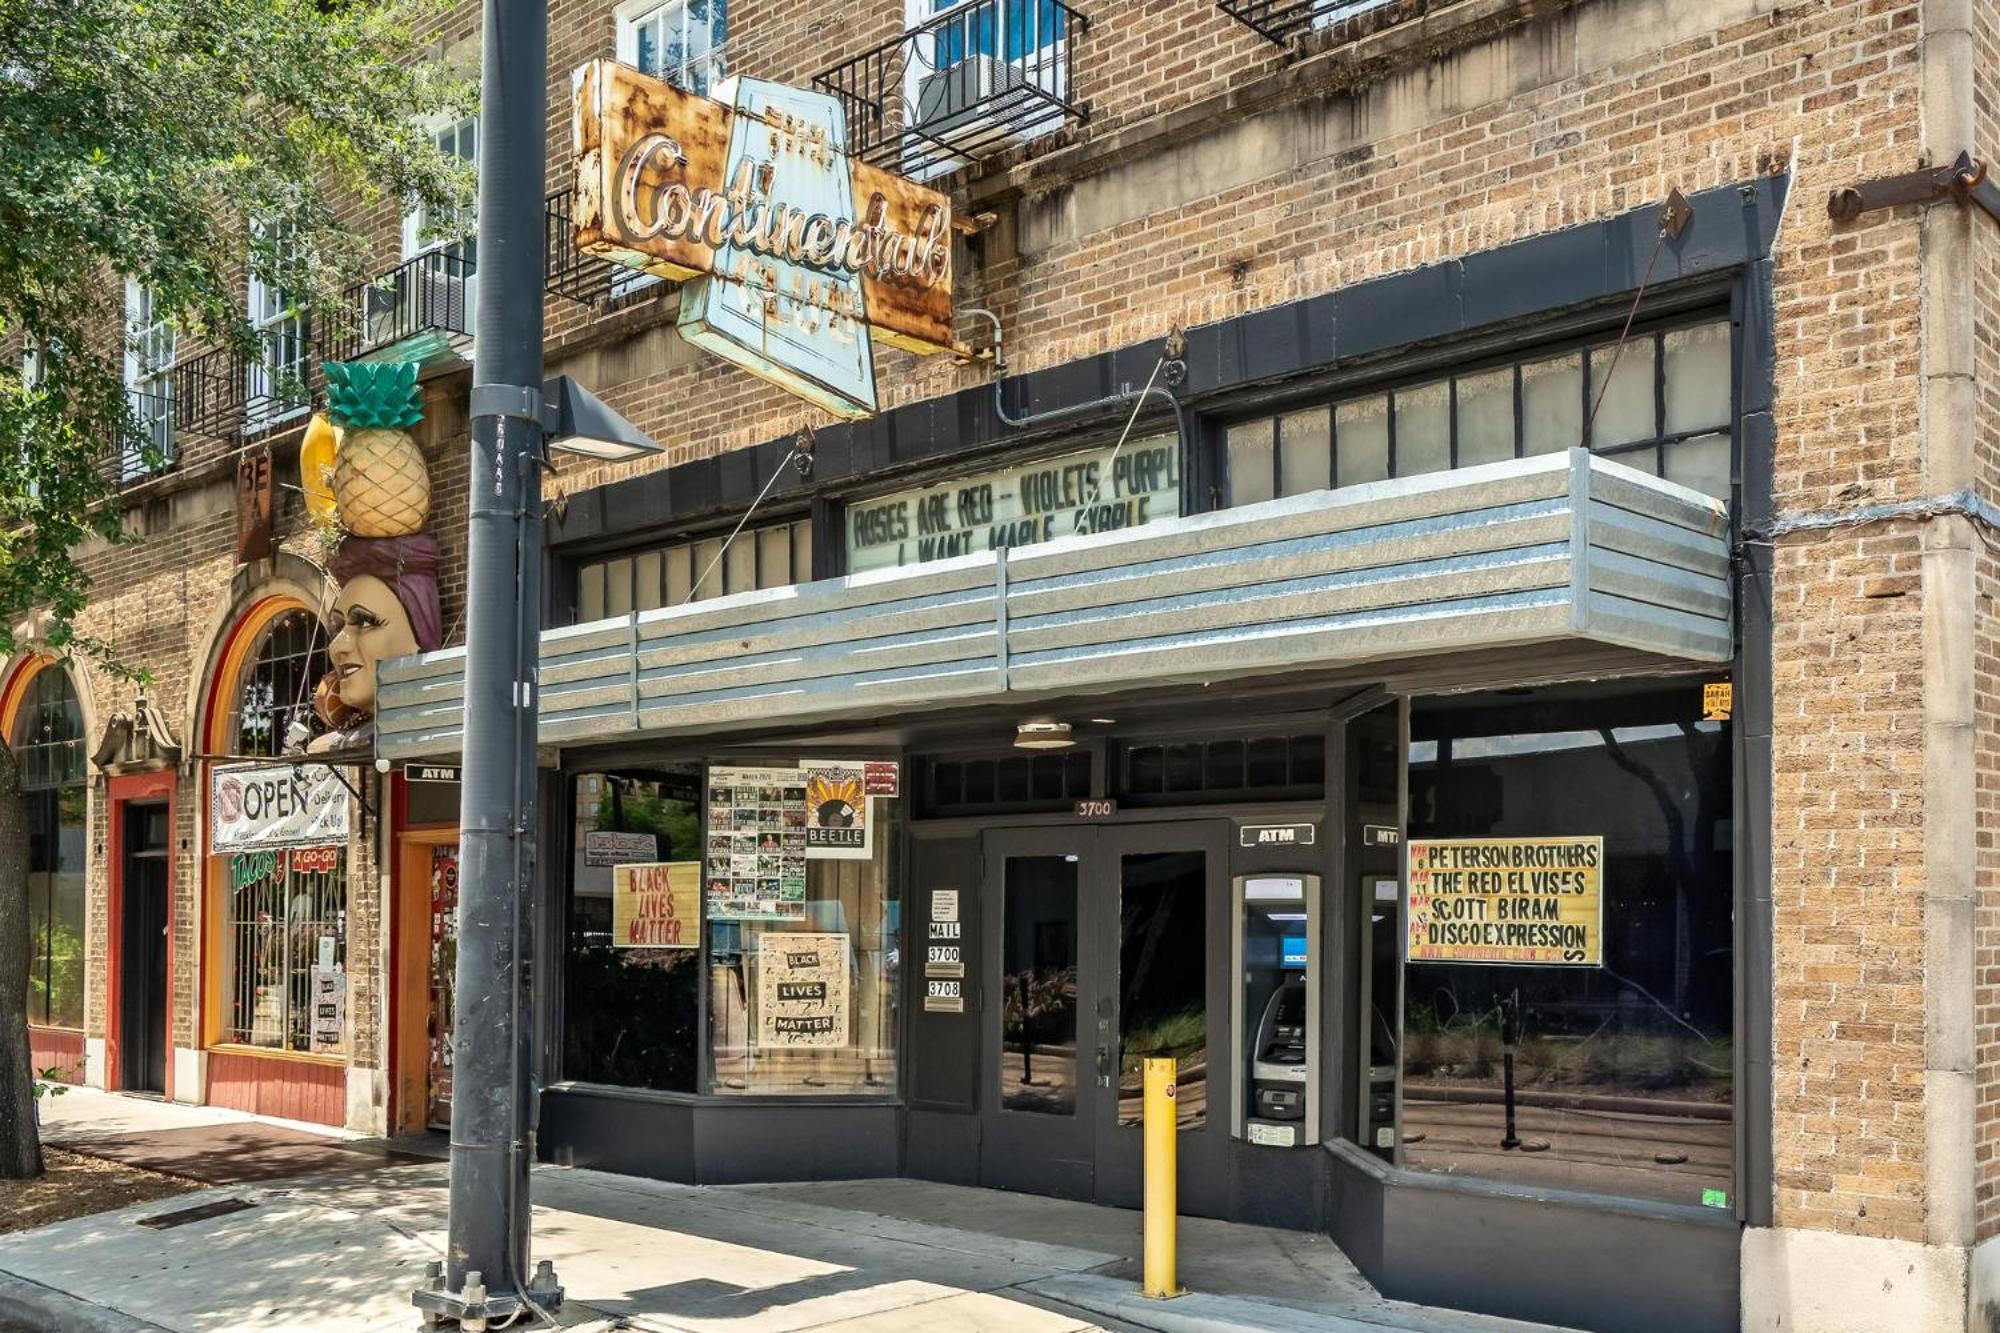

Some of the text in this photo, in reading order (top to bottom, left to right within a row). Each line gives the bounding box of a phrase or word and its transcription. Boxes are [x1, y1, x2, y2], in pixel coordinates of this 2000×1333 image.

[612, 132, 950, 286] Continental
[853, 501, 909, 548] ROSES
[917, 492, 952, 536] ARE
[957, 483, 993, 528] RED
[1020, 460, 1100, 515] VIOLETS
[1113, 446, 1179, 498] PURPL
[918, 530, 973, 563] WANT
[421, 768, 454, 779] ATM
[244, 777, 308, 820] OPEN
[1079, 801, 1111, 817] 3700
[810, 829, 861, 842] BEETLE
[1258, 829, 1295, 843] ATM
[295, 850, 337, 862] A GO-GO
[1429, 846, 1510, 868] PETERSON
[1513, 844, 1597, 868] BROTHERS
[232, 850, 277, 894] TACOS
[630, 867, 671, 893] BLACK
[1432, 872, 1463, 894] THE
[1468, 872, 1500, 894] RED
[1508, 871, 1585, 894] ELVISES
[639, 894, 674, 918] LIVES
[1432, 898, 1487, 921] SCOTT
[1498, 899, 1559, 921] BIRAM
[629, 919, 682, 944] MATTER
[930, 923, 959, 938] MAIL
[1429, 923, 1480, 945] DISCO
[789, 955, 818, 965] BLACK
[930, 948, 959, 961] 3700
[783, 986, 822, 997] LIVES
[930, 983, 959, 996] 3708
[777, 1019, 831, 1030] MATTER
